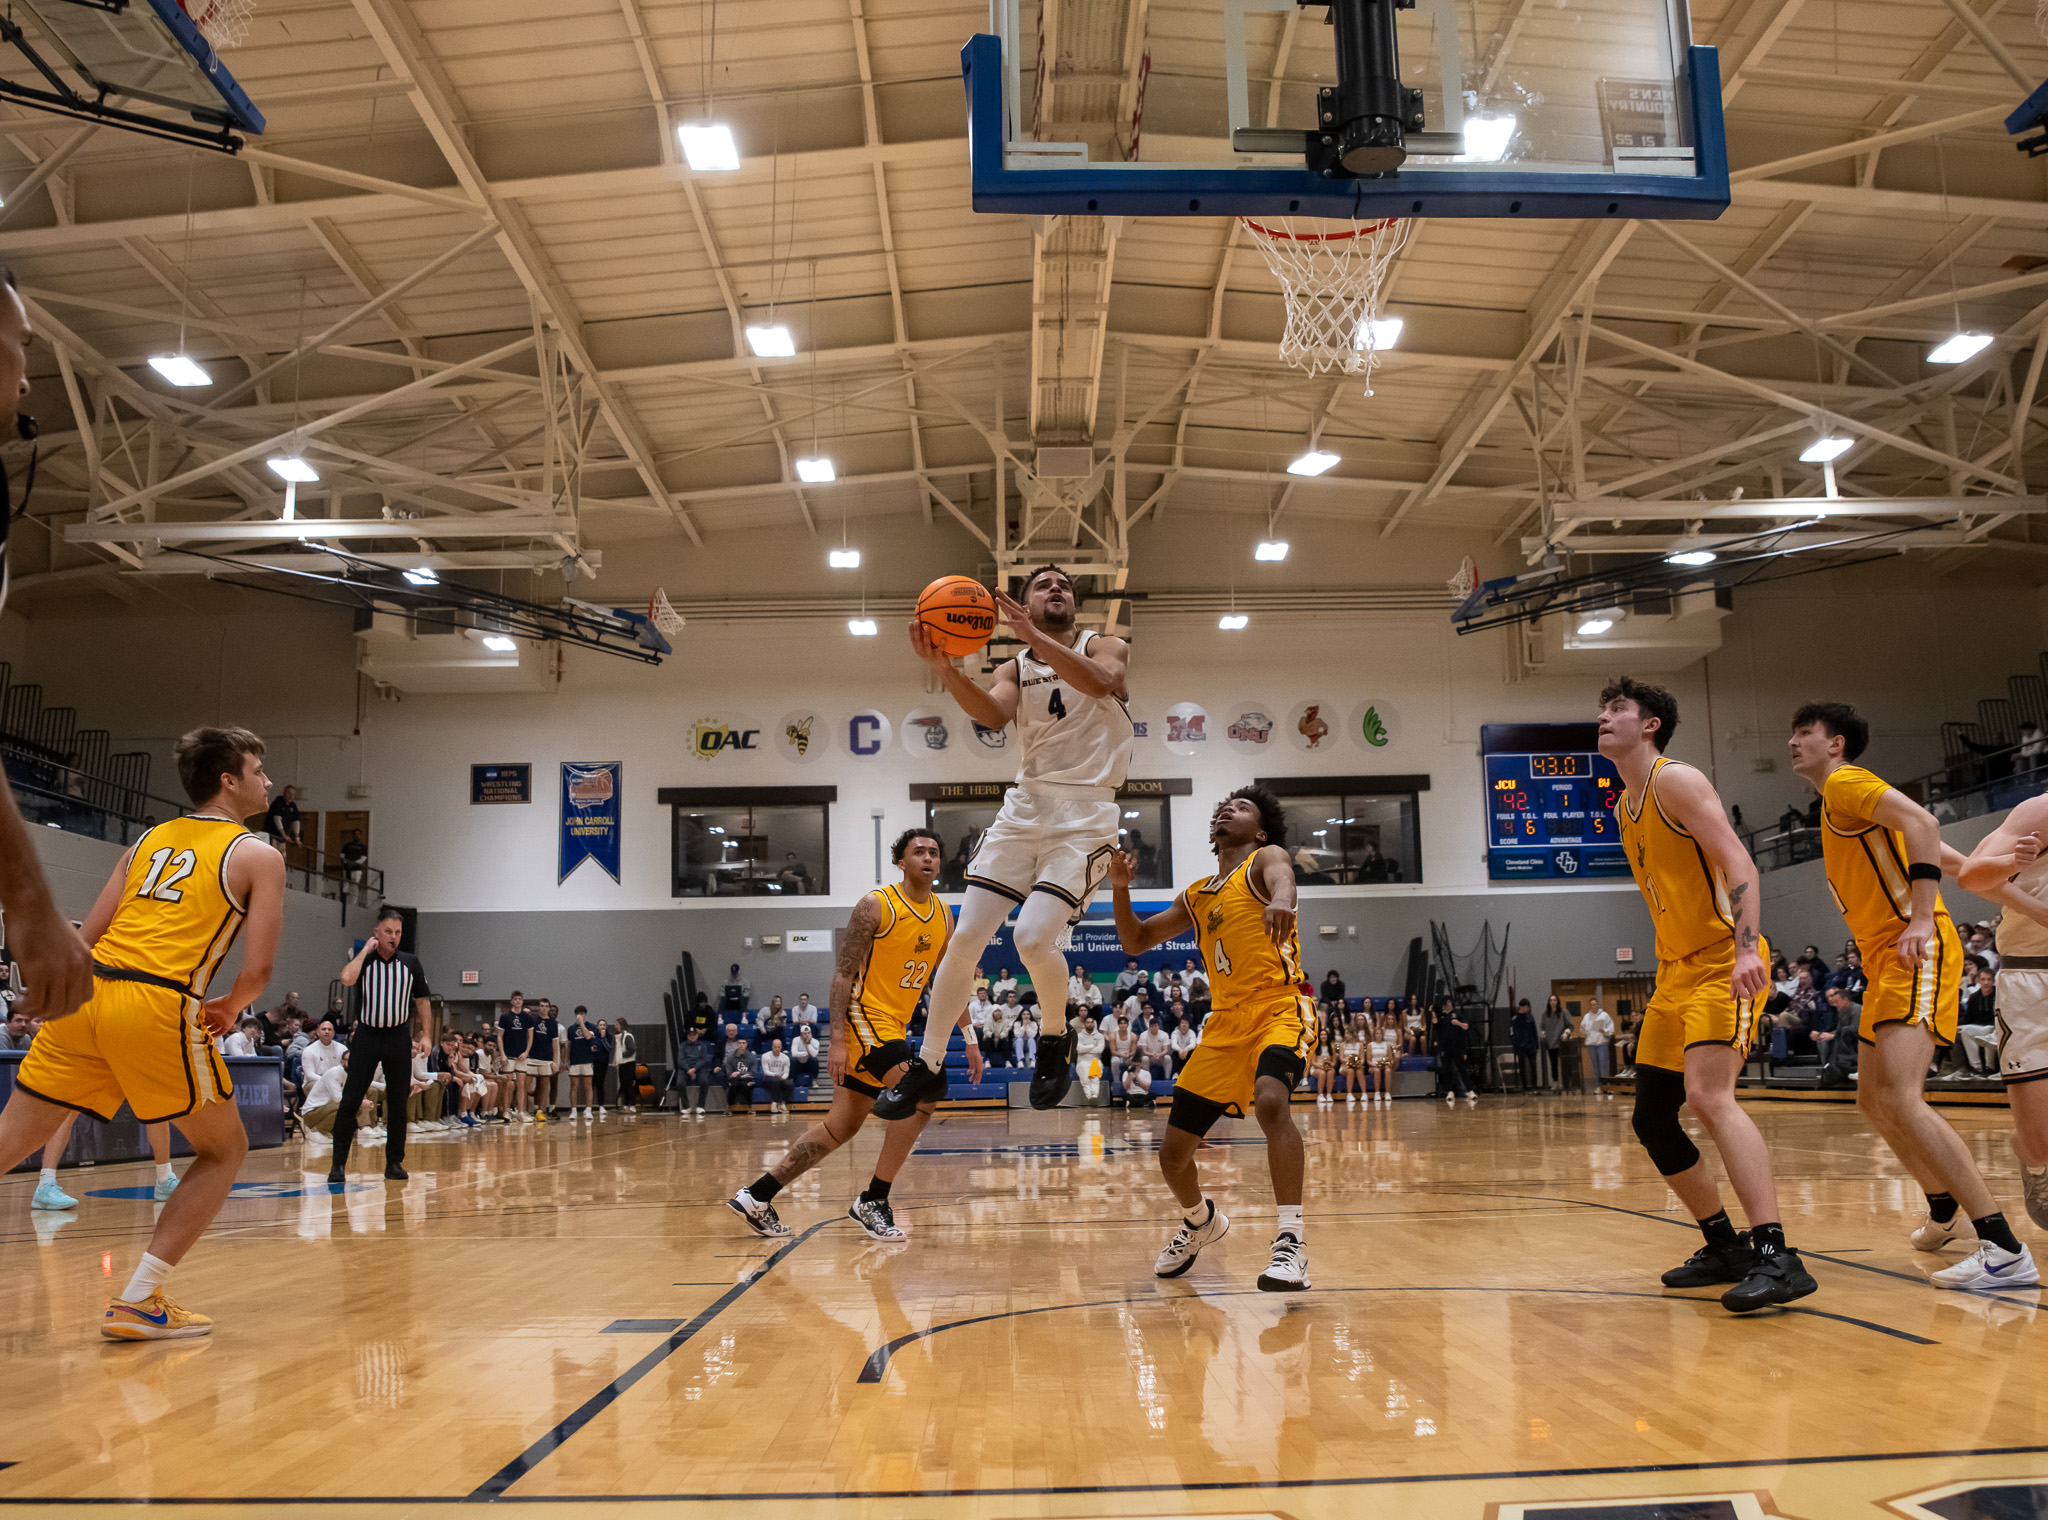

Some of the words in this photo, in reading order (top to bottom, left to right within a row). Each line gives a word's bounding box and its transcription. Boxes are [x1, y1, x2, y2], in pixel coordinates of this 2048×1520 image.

[946, 612, 993, 631] Wilson
[1022, 677, 1042, 687] BLUE
[1042, 674, 1060, 683] STR
[1048, 688, 1067, 720] 4
[700, 730, 760, 750] OAC
[850, 715, 881, 755] C
[1227, 725, 1269, 743] ONU
[1534, 756, 1576, 775] 43.0
[480, 780, 522, 788] WRESTLING
[1127, 782, 1162, 792] ROOM
[1494, 779, 1516, 790] JCU
[1598, 777, 1611, 788] BW
[939, 785, 964, 796] THE
[969, 785, 1000, 795] HERB
[1503, 791, 1528, 811] 42
[1563, 794, 1568, 807] 1
[565, 816, 584, 826] JOHN
[584, 816, 615, 825] CARROLL
[1562, 811, 1585, 819] PLAYER
[570, 826, 609, 836] UNIVERSITY
[1504, 822, 1513, 834] 4
[1525, 820, 1536, 835] 6
[1594, 818, 1604, 833] 5
[1550, 836, 1583, 844] ADVANTAGE
[136, 846, 197, 904] 12
[1071, 933, 1083, 941] cal
[1085, 933, 1117, 942] Provider
[1087, 942, 1124, 952] Univers
[1165, 941, 1199, 951] Streak
[1213, 937, 1233, 977] 4
[899, 959, 929, 989] 22
